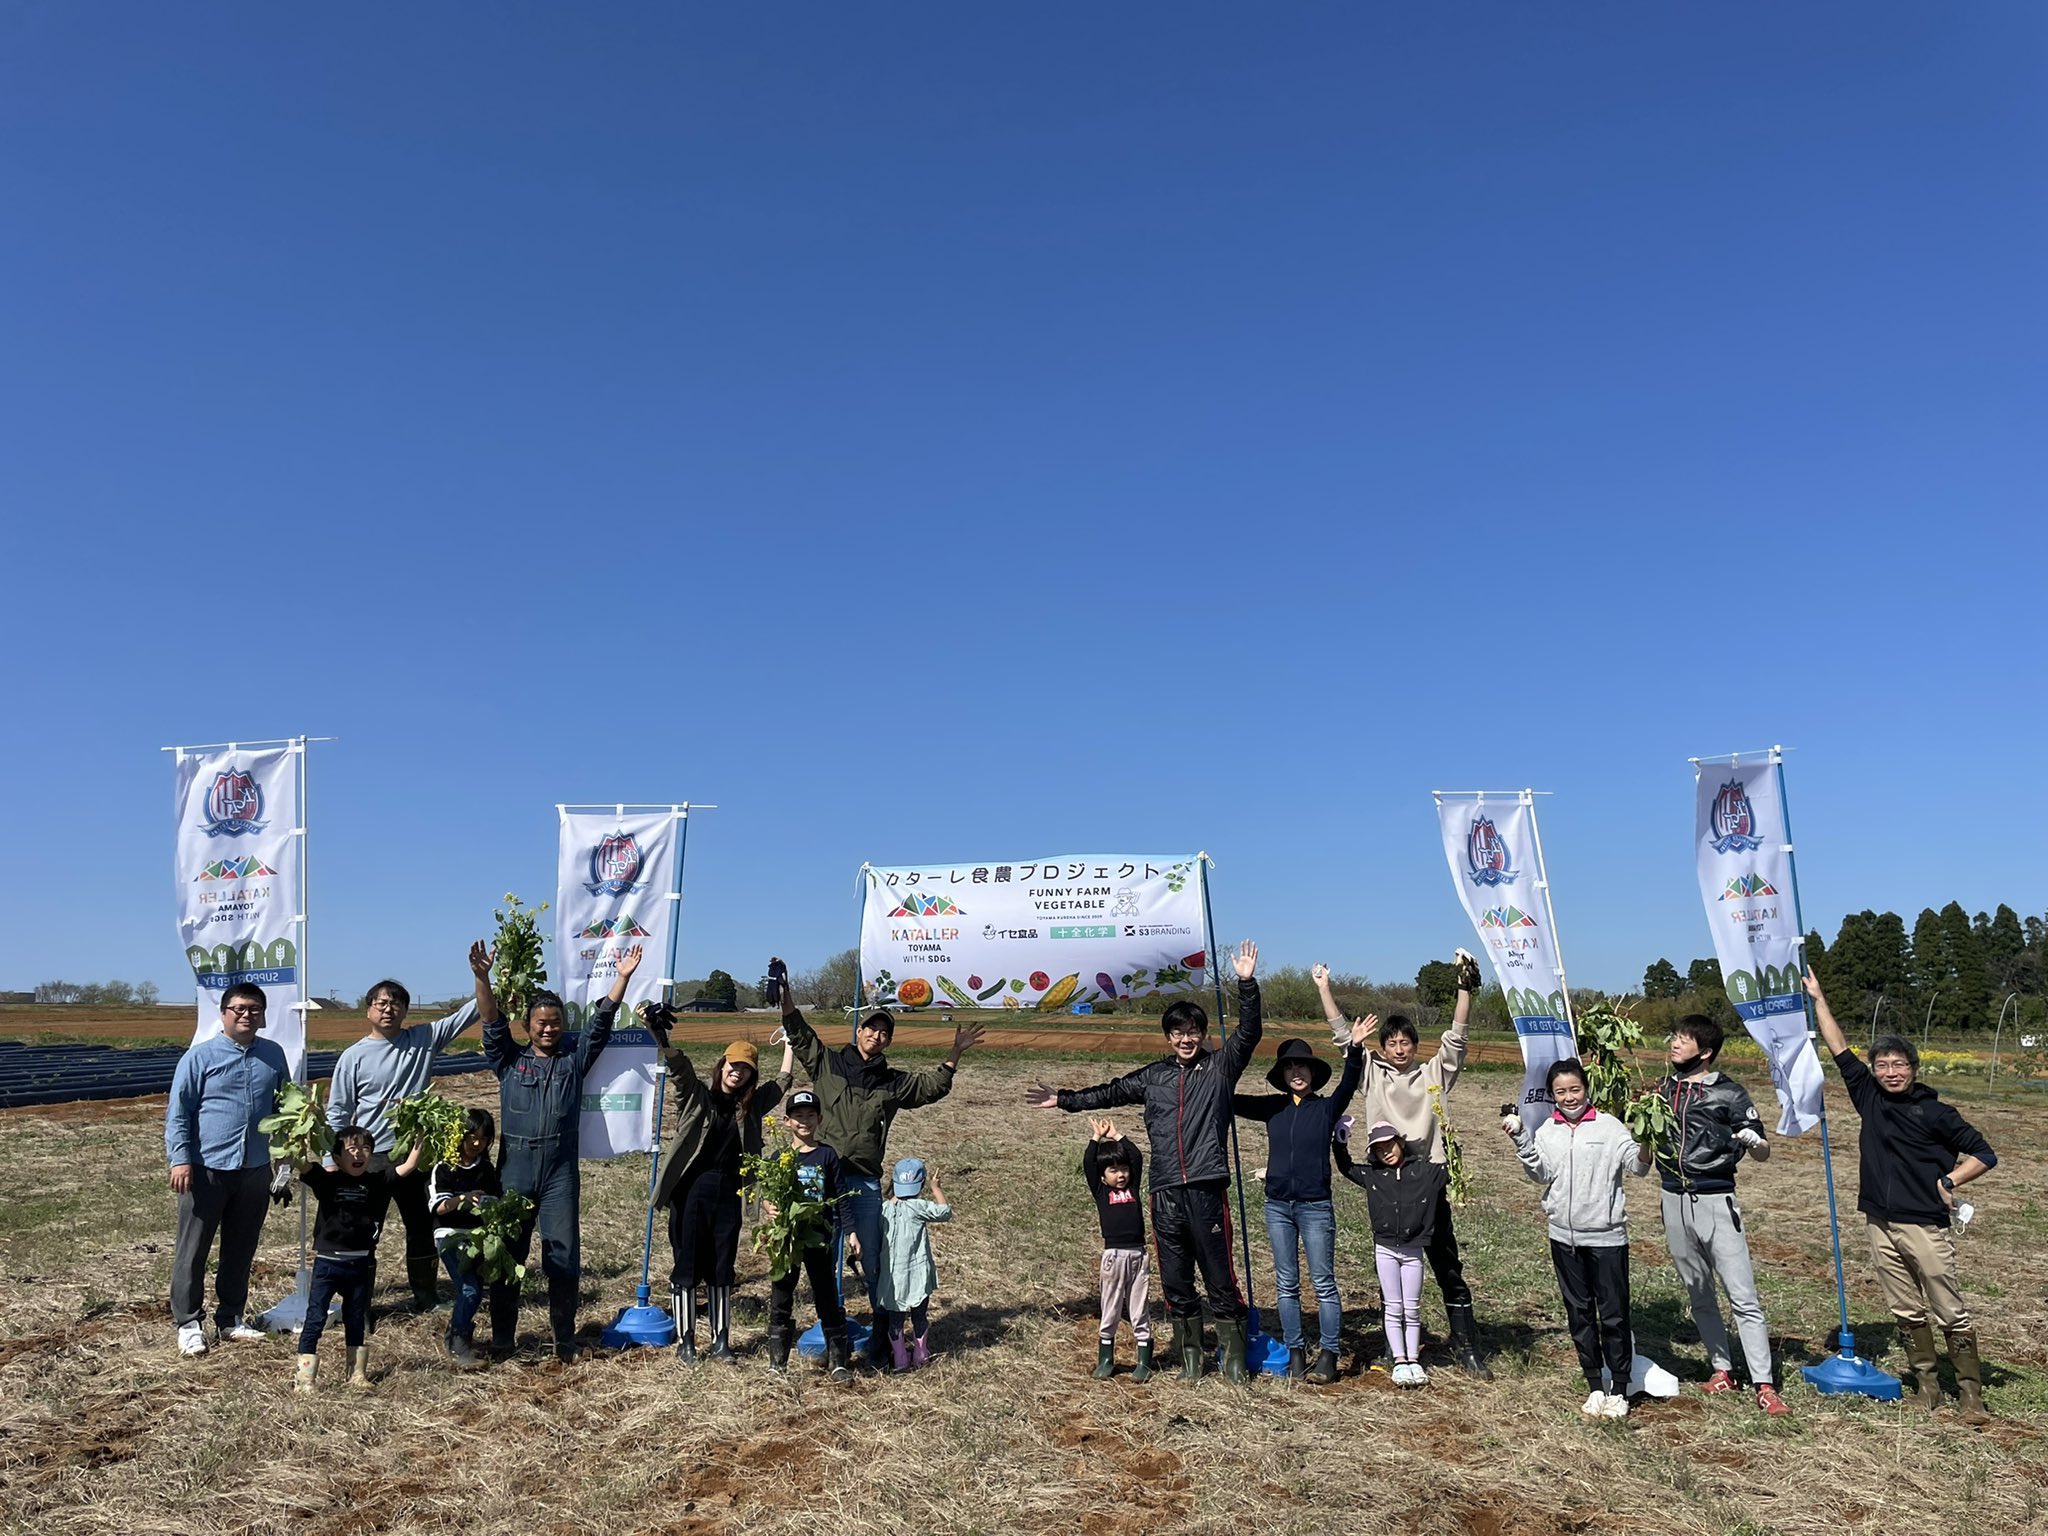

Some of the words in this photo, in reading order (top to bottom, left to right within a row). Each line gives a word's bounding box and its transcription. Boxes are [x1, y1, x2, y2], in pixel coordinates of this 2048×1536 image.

[886, 862, 1159, 886] カターレ食農プロジェクト
[1029, 888, 1072, 897] FUNNY
[1077, 887, 1111, 896] FARM
[1035, 900, 1105, 910] VEGETABLE
[891, 928, 960, 941] KATALLER
[998, 928, 1038, 939] イセ食品
[1057, 926, 1109, 938] 十全化学
[908, 944, 942, 952] TOYAMA
[903, 955, 925, 963] WITH
[927, 954, 952, 963] SDGs
